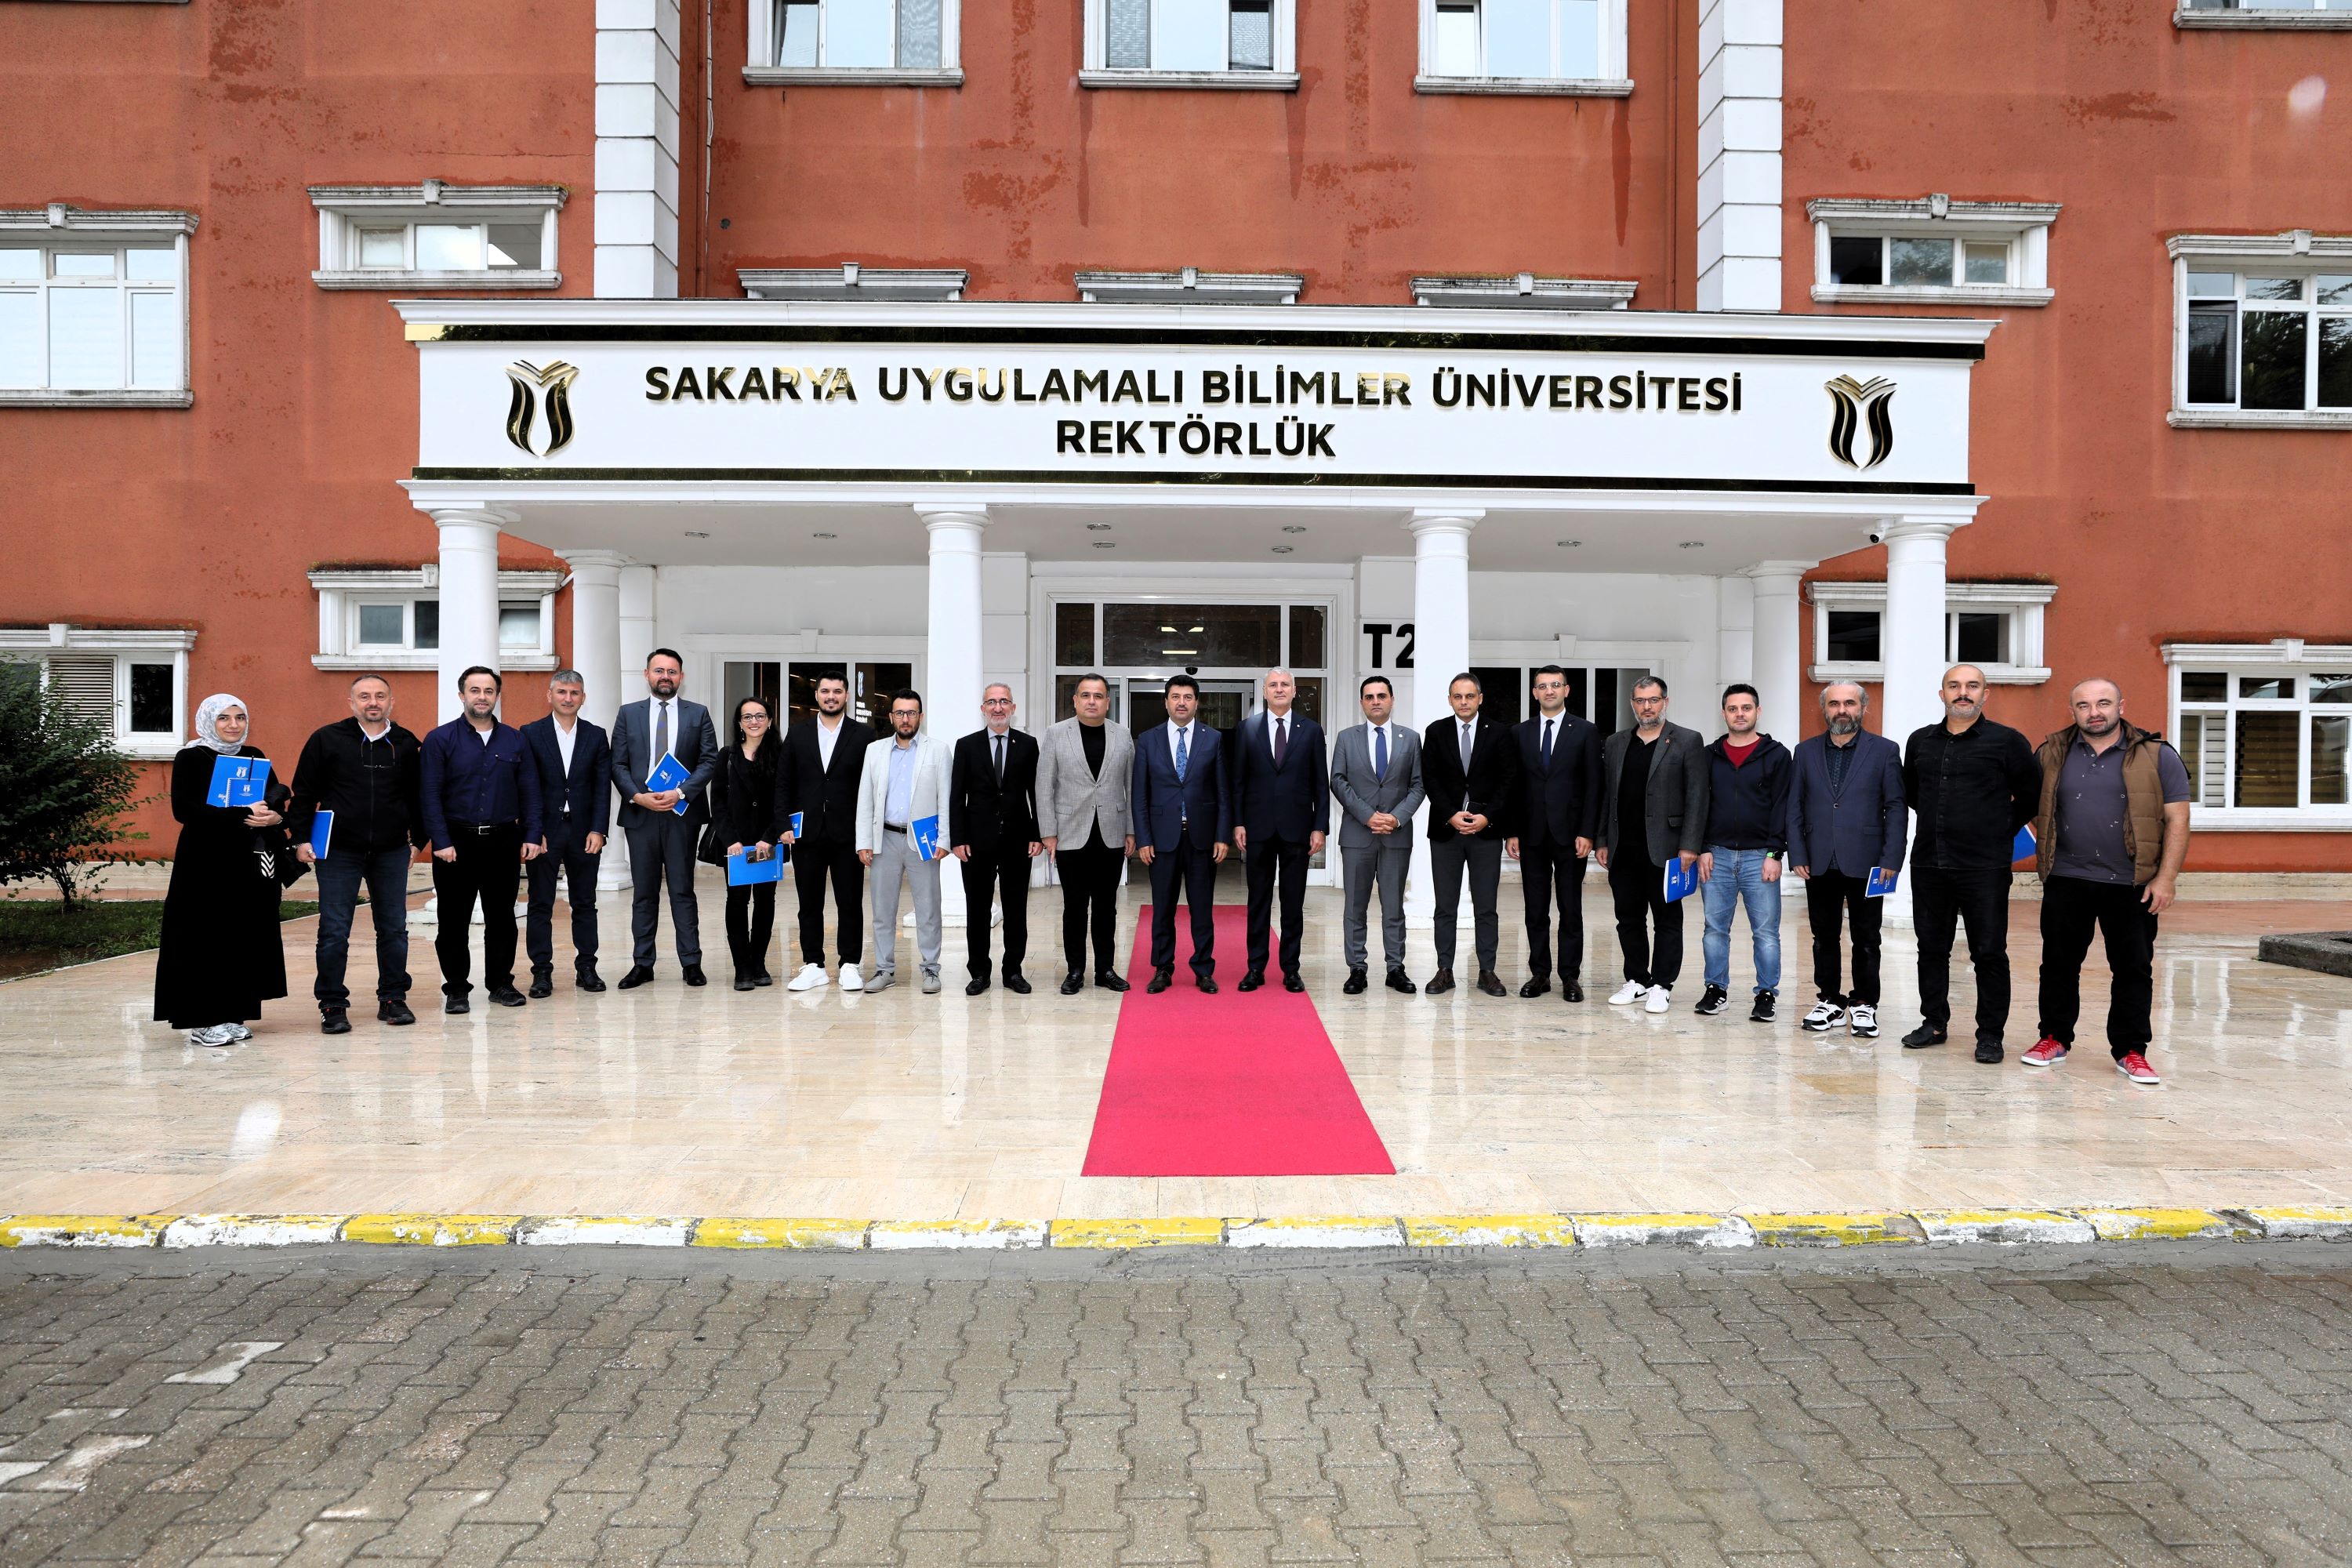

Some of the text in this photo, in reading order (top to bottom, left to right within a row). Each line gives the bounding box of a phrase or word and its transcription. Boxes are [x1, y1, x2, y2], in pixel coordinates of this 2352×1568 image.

[645, 364, 1741, 412] SAKARYA UYGULAMALI BİLİMLER ÜNİVERSİTESİ
[1057, 413, 1337, 457] REKTÖRLÜK
[1363, 623, 1415, 669] T2
